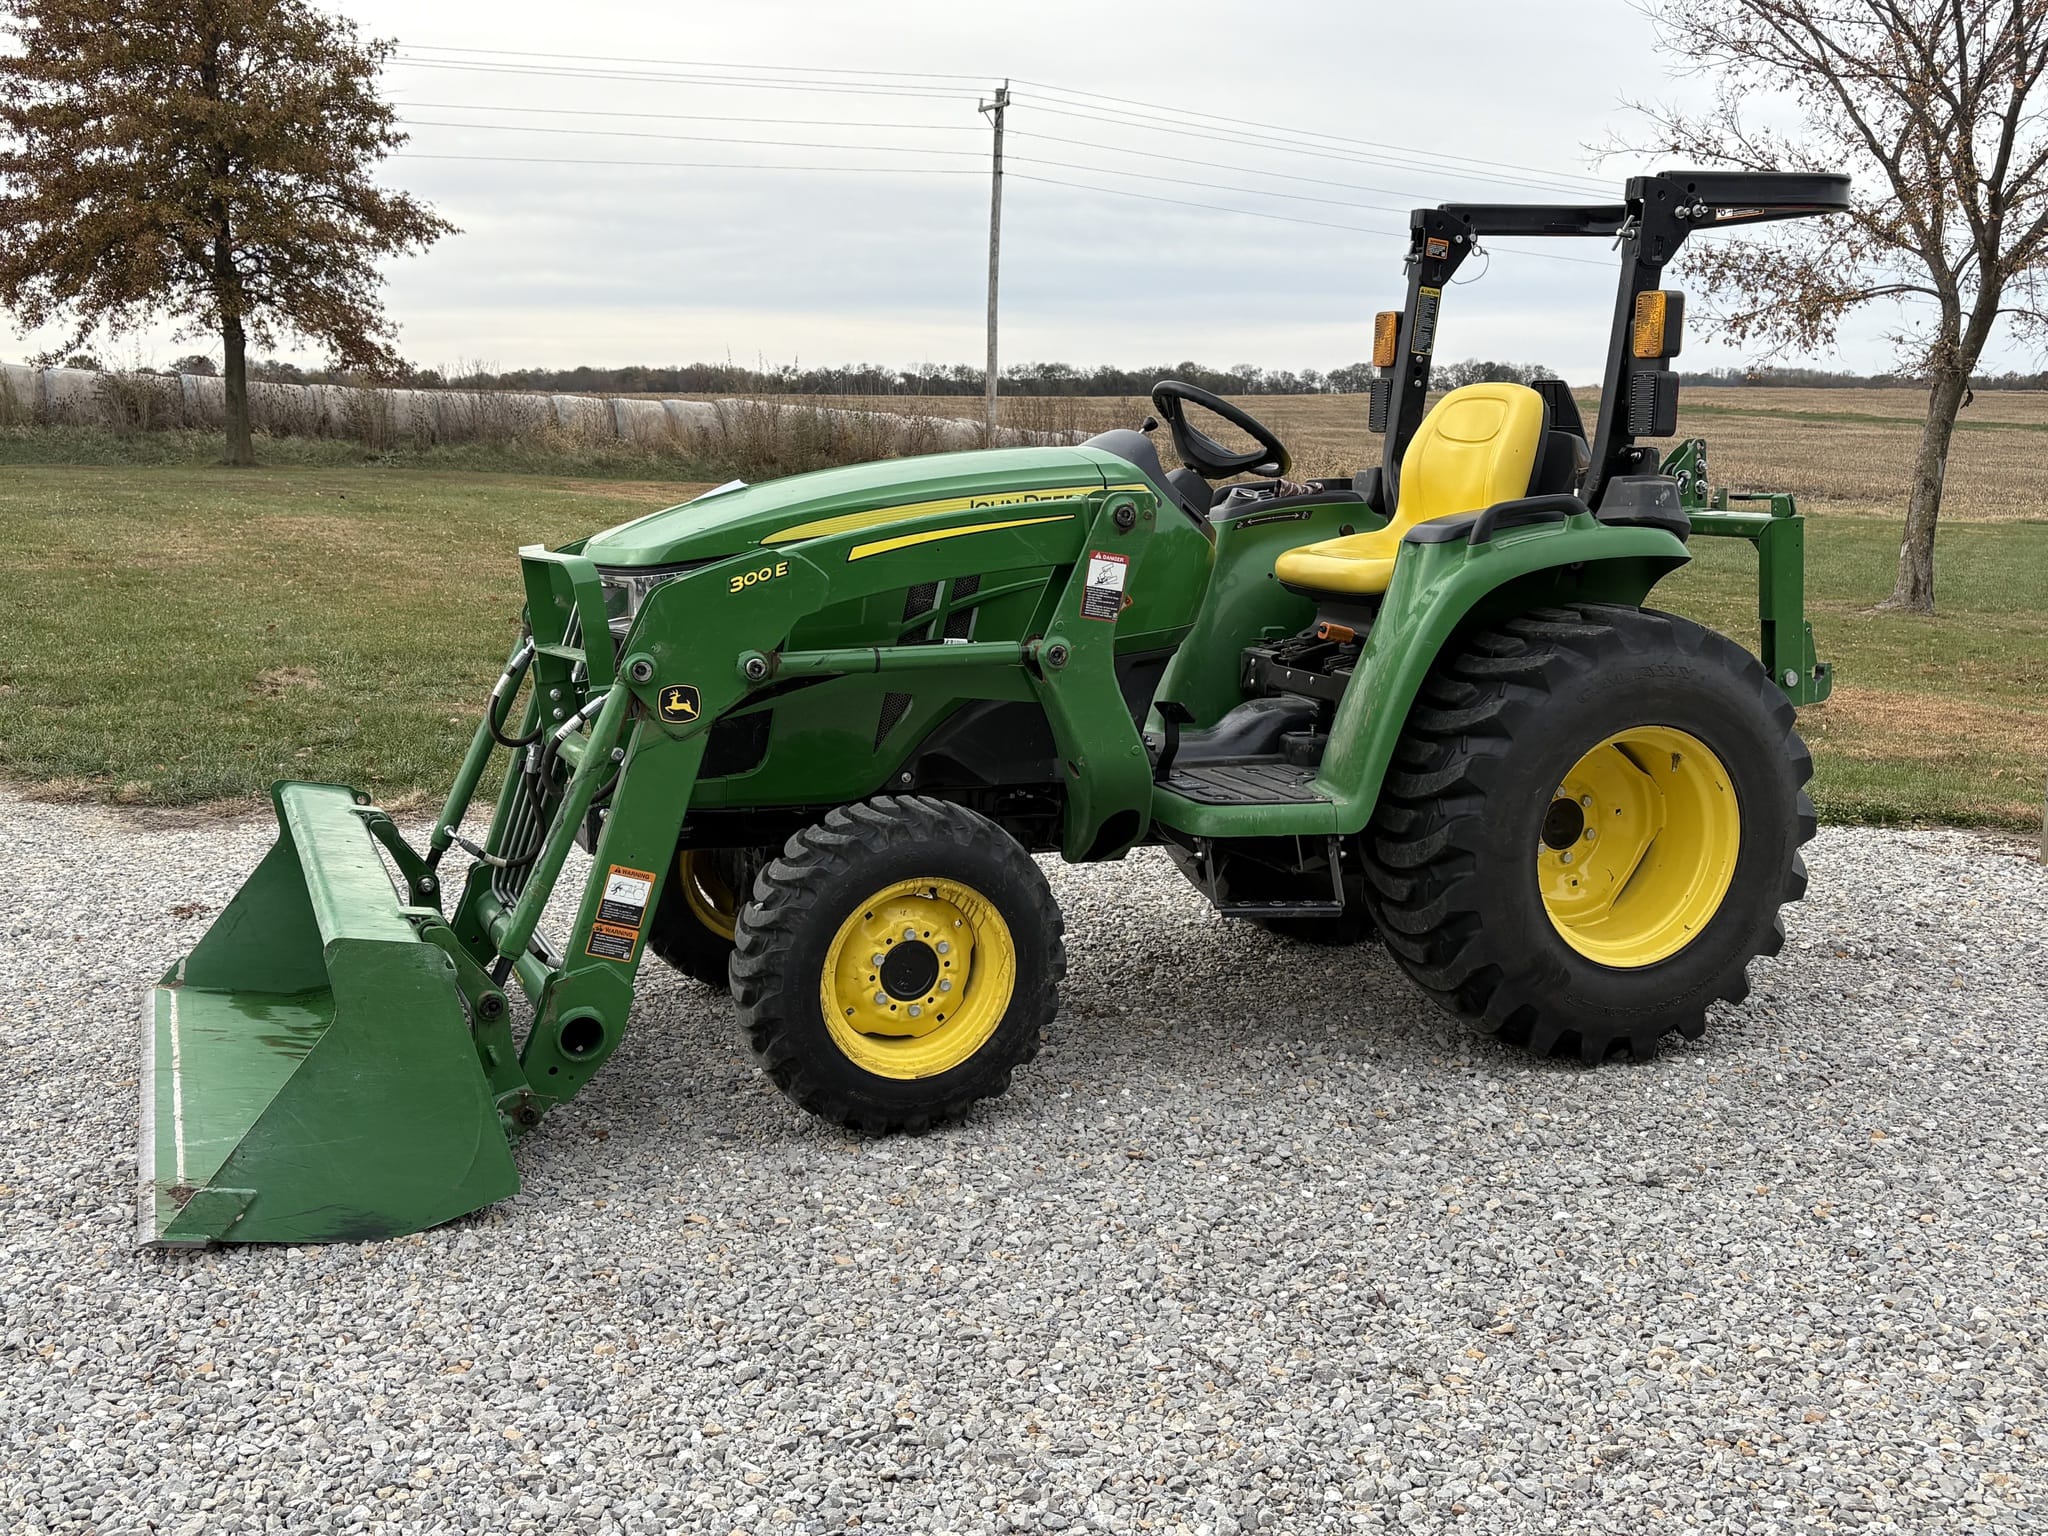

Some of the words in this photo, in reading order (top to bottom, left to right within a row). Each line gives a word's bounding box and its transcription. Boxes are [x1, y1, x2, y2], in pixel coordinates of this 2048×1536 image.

[1102, 554, 1125, 563] DANGER
[621, 869, 651, 880] WARNING
[604, 927, 634, 938] WARNING
